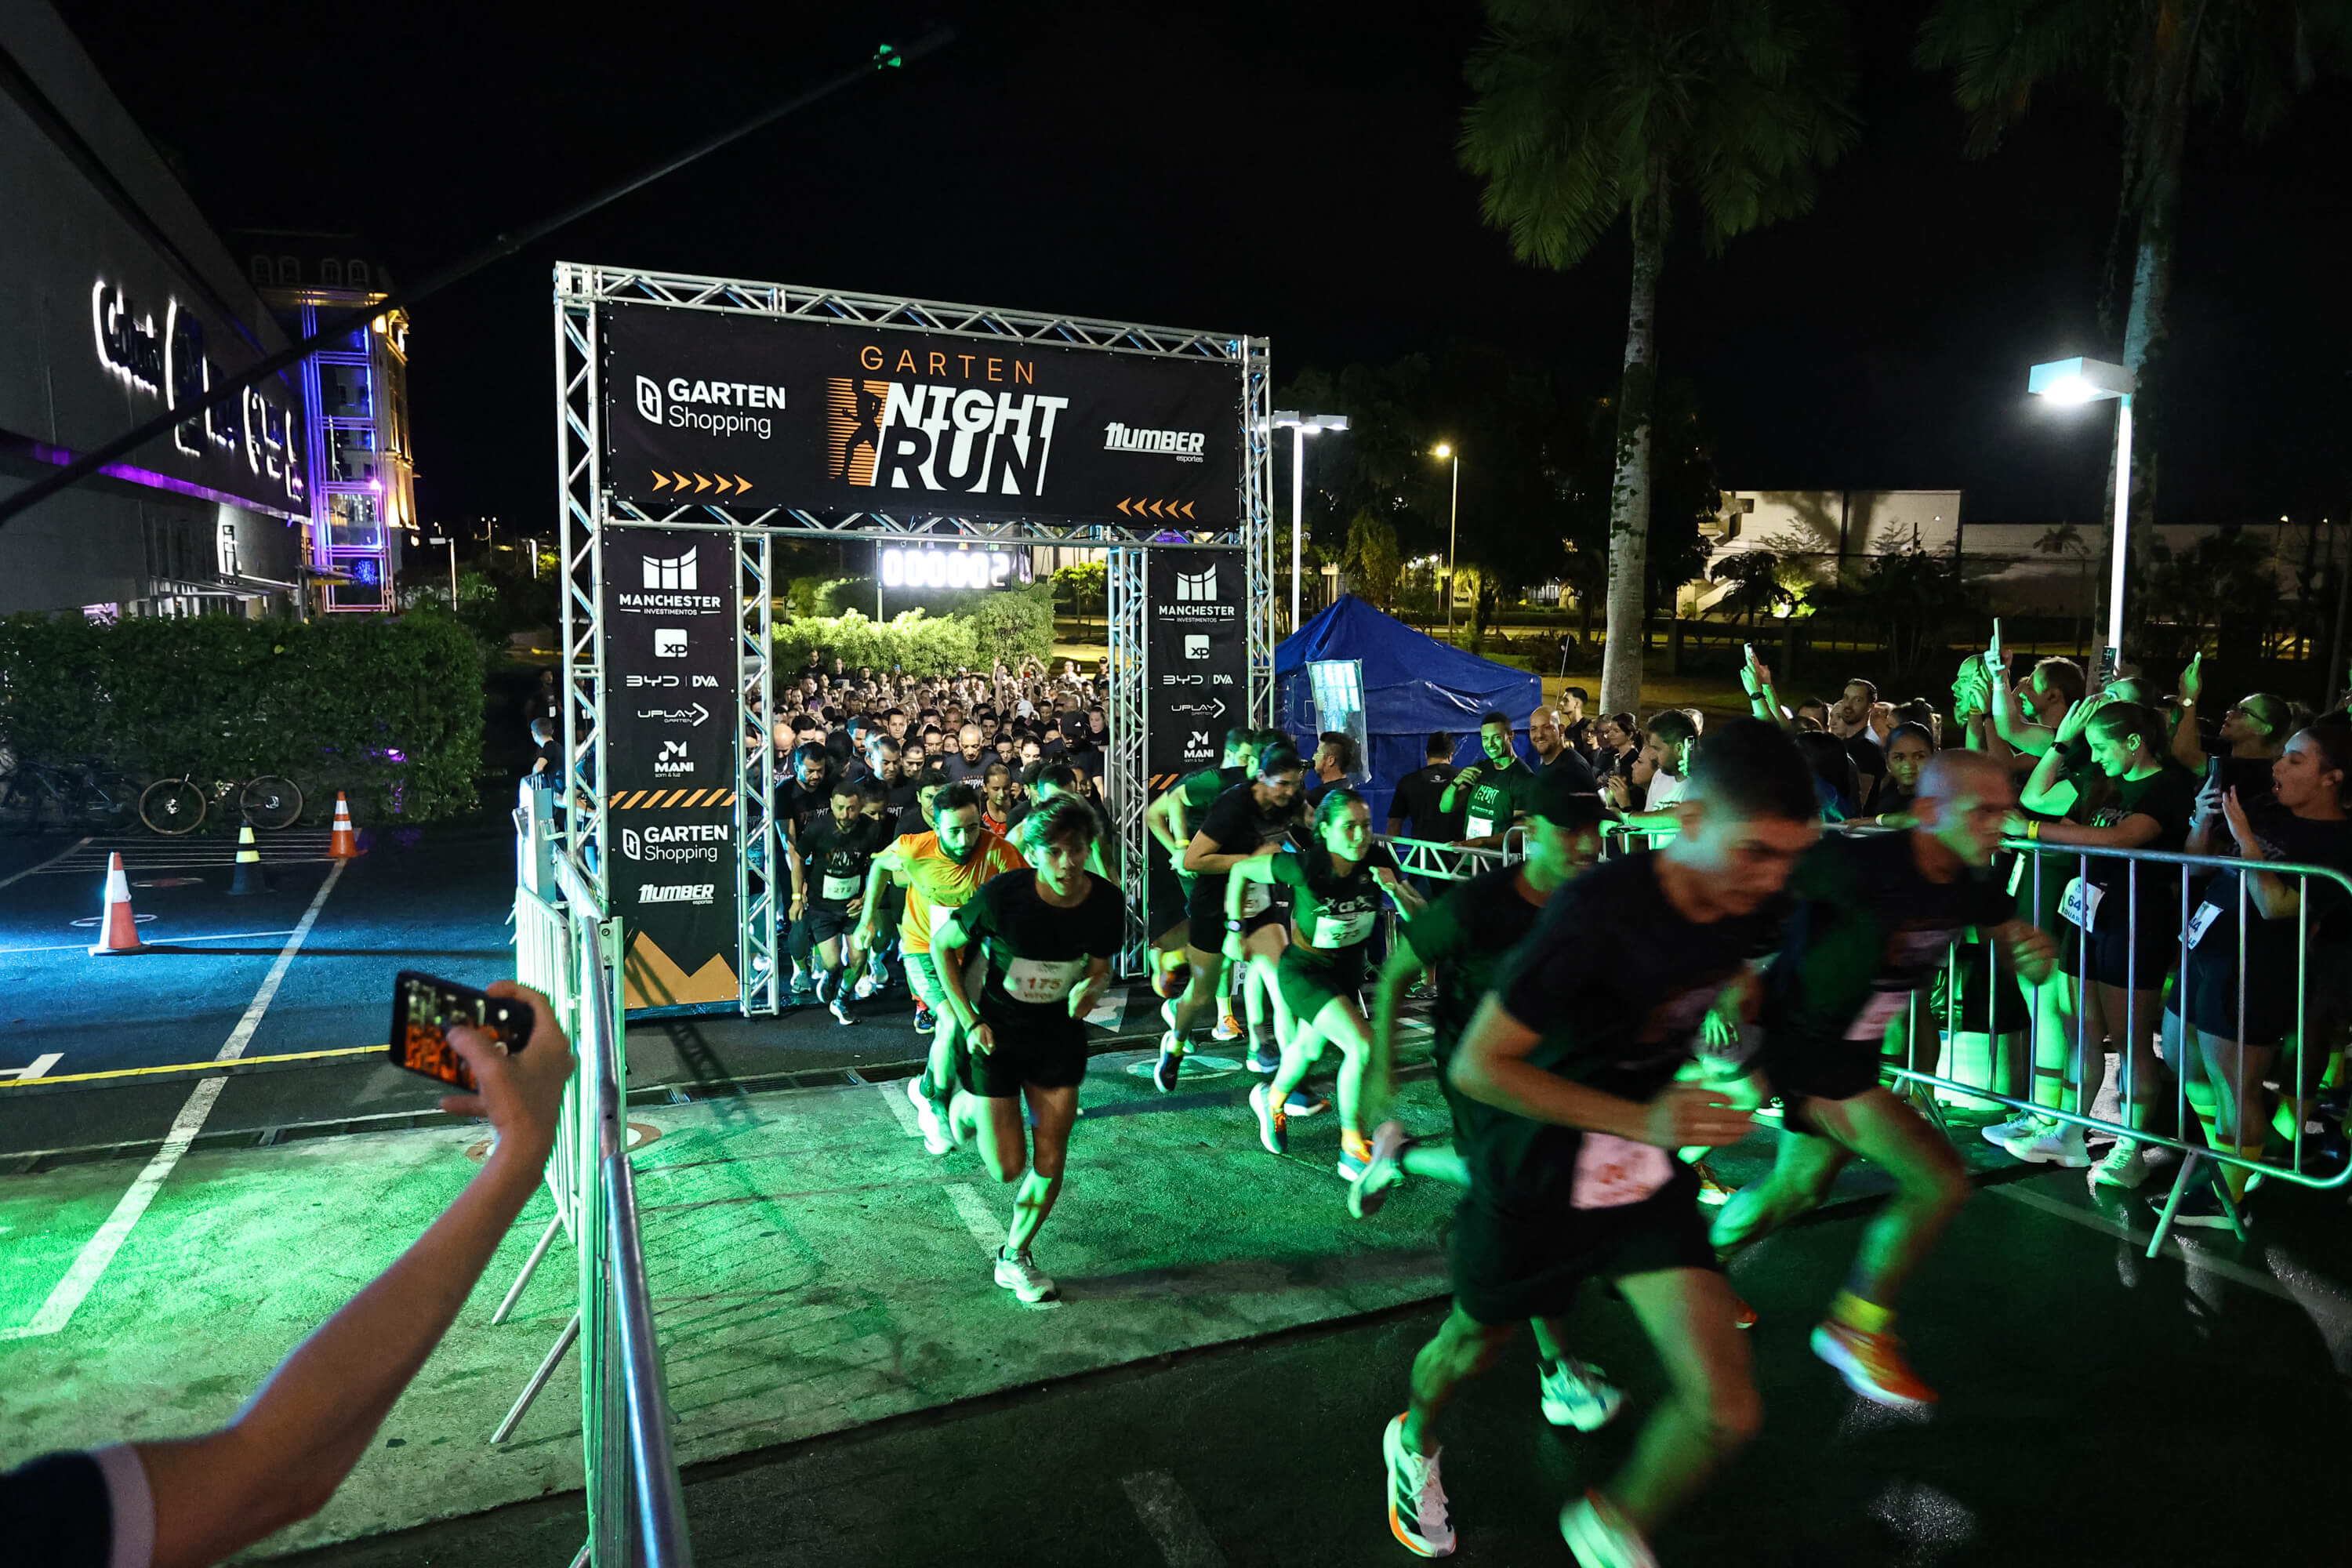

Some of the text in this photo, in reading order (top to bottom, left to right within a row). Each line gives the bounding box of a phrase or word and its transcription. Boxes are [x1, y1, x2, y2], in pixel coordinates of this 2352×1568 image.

[860, 345, 1034, 385] GARTEN
[667, 378, 786, 409] GARTEN
[885, 381, 1069, 438] NIGHT
[668, 405, 771, 440] Shopping
[875, 425, 1047, 496] RUN
[619, 593, 721, 608] MANCHESTER
[1159, 605, 1235, 615] MANCHESTER
[626, 675, 719, 688] BYD DVA
[1163, 674, 1233, 684] BYD DVA
[1184, 749, 1214, 758] MANI
[655, 762, 694, 772] MANI
[644, 825, 728, 844] GARTEN
[644, 844, 718, 864] Shopping
